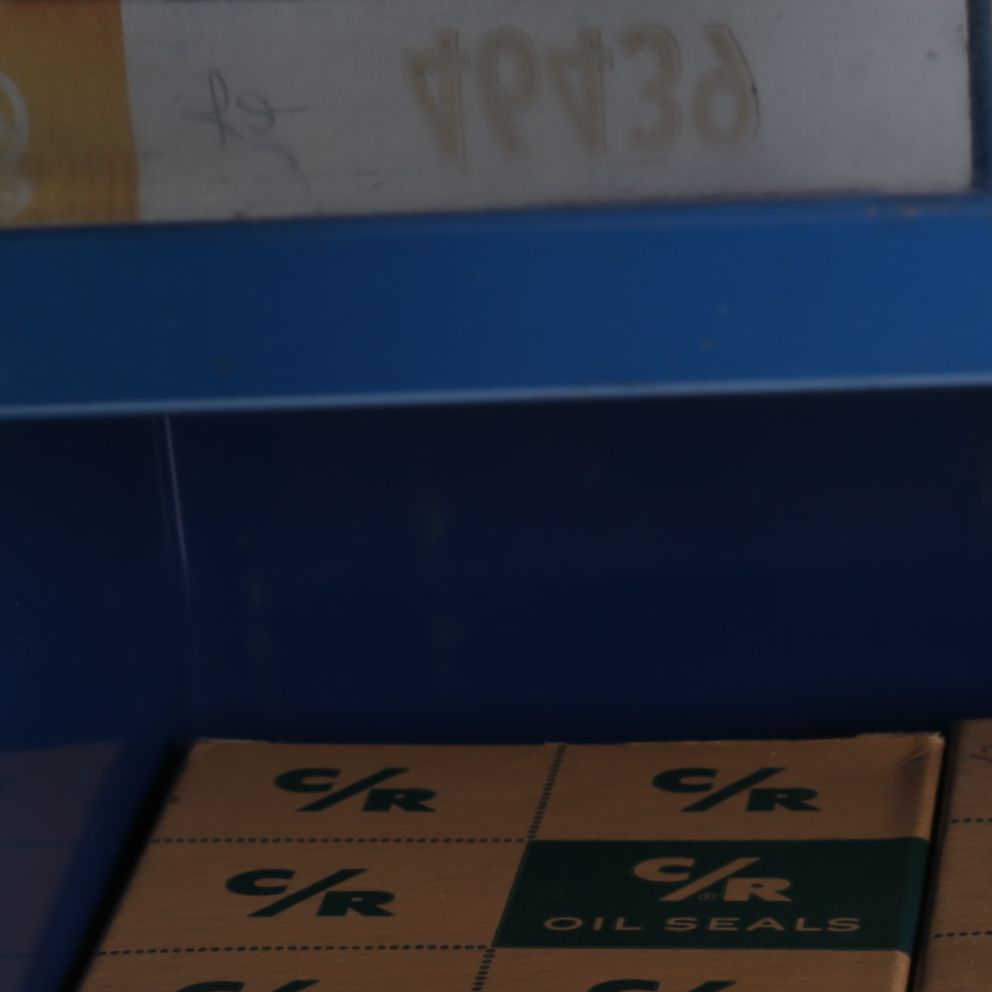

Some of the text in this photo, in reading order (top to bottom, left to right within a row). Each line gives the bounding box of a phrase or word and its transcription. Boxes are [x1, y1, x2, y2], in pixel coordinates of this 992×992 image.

[274, 767, 436, 813] C/R
[652, 767, 820, 813] C/R
[225, 868, 396, 918] C/R
[544, 916, 861, 932] OIL SEALS
